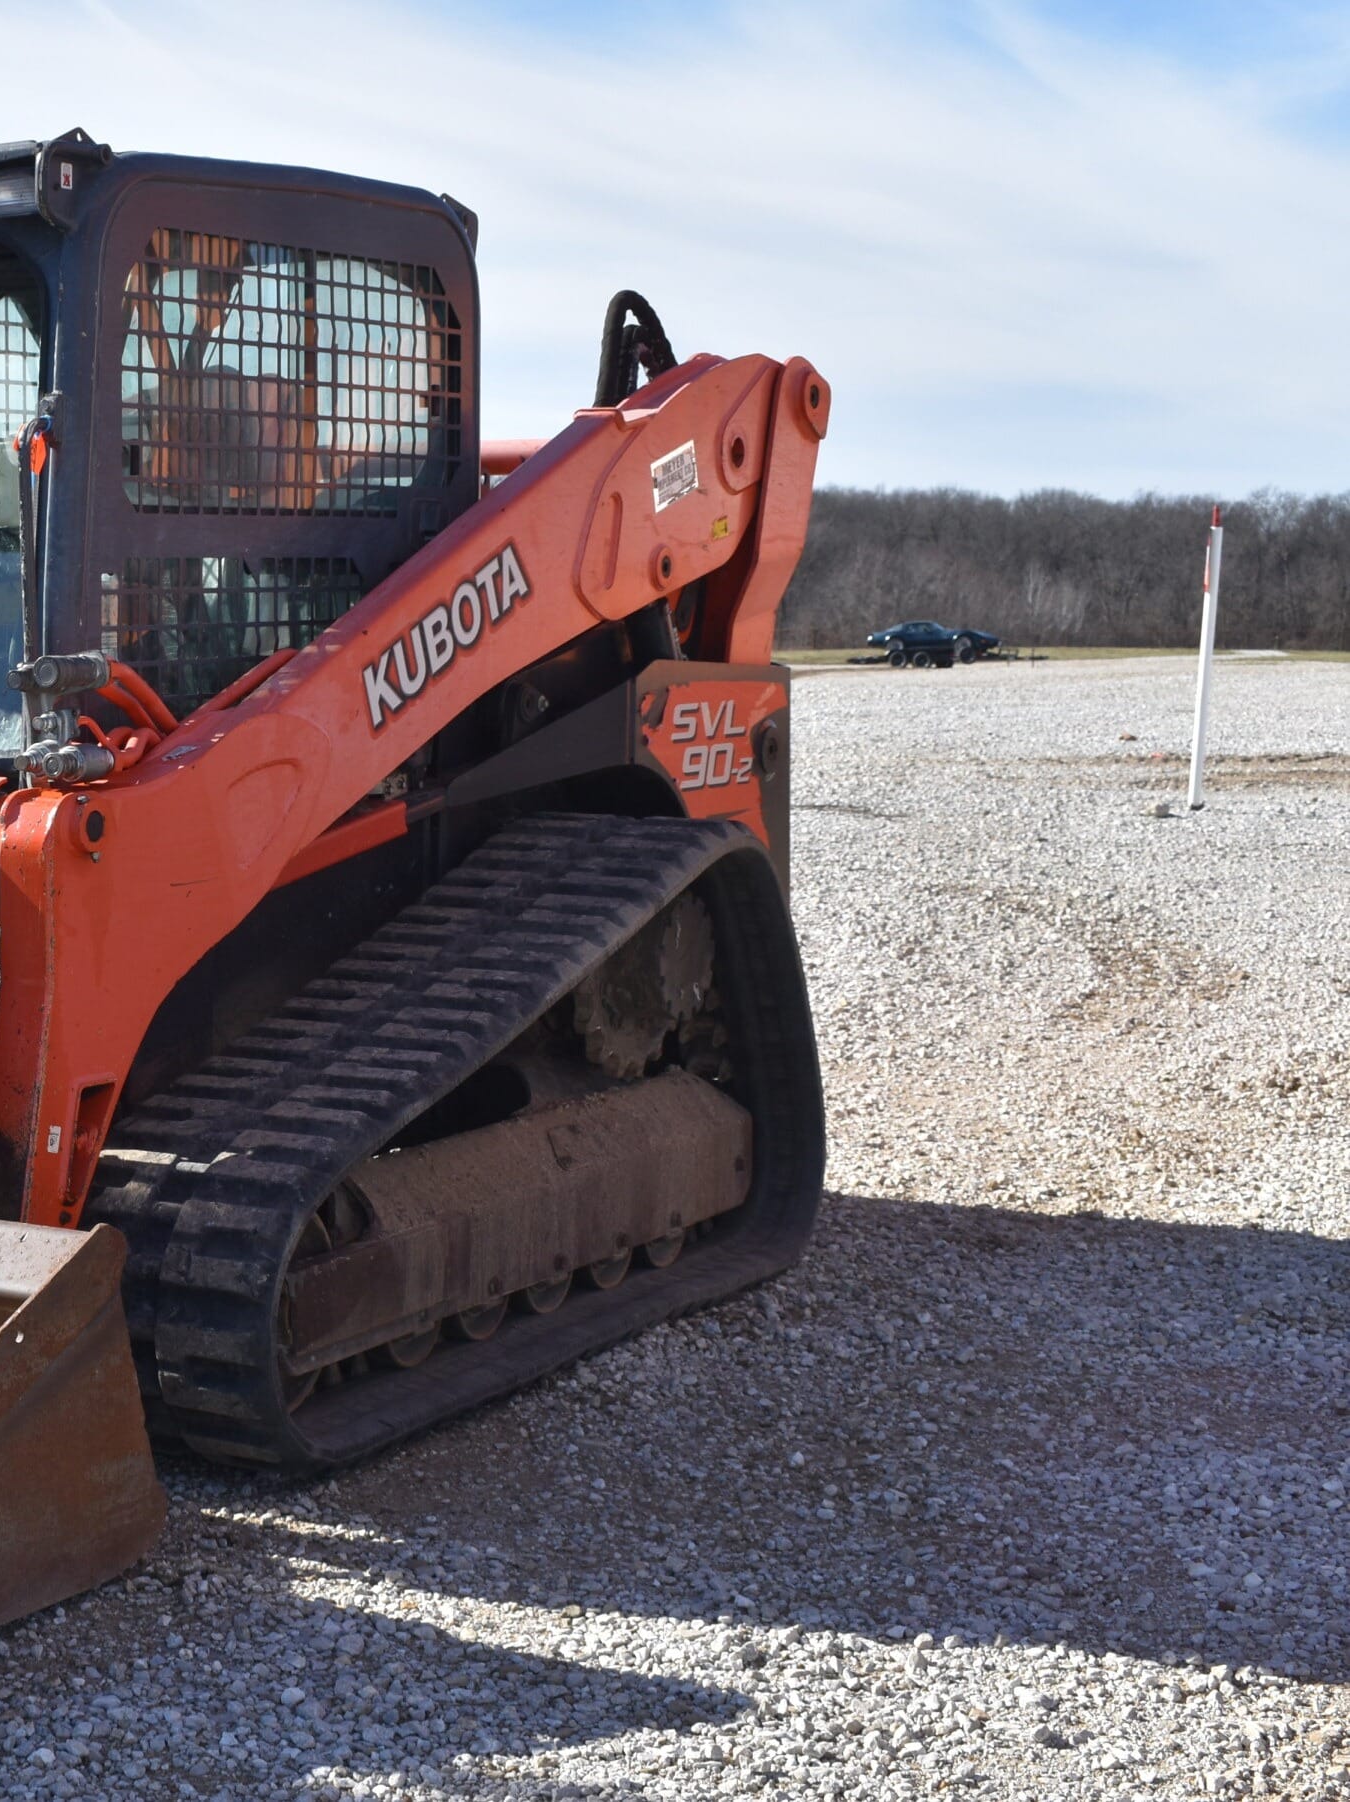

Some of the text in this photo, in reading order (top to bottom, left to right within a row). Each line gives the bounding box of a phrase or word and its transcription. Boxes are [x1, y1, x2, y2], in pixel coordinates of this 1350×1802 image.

[361, 543, 530, 729] KUBOTA
[671, 699, 747, 742] SVL
[679, 742, 754, 791] 90-2
